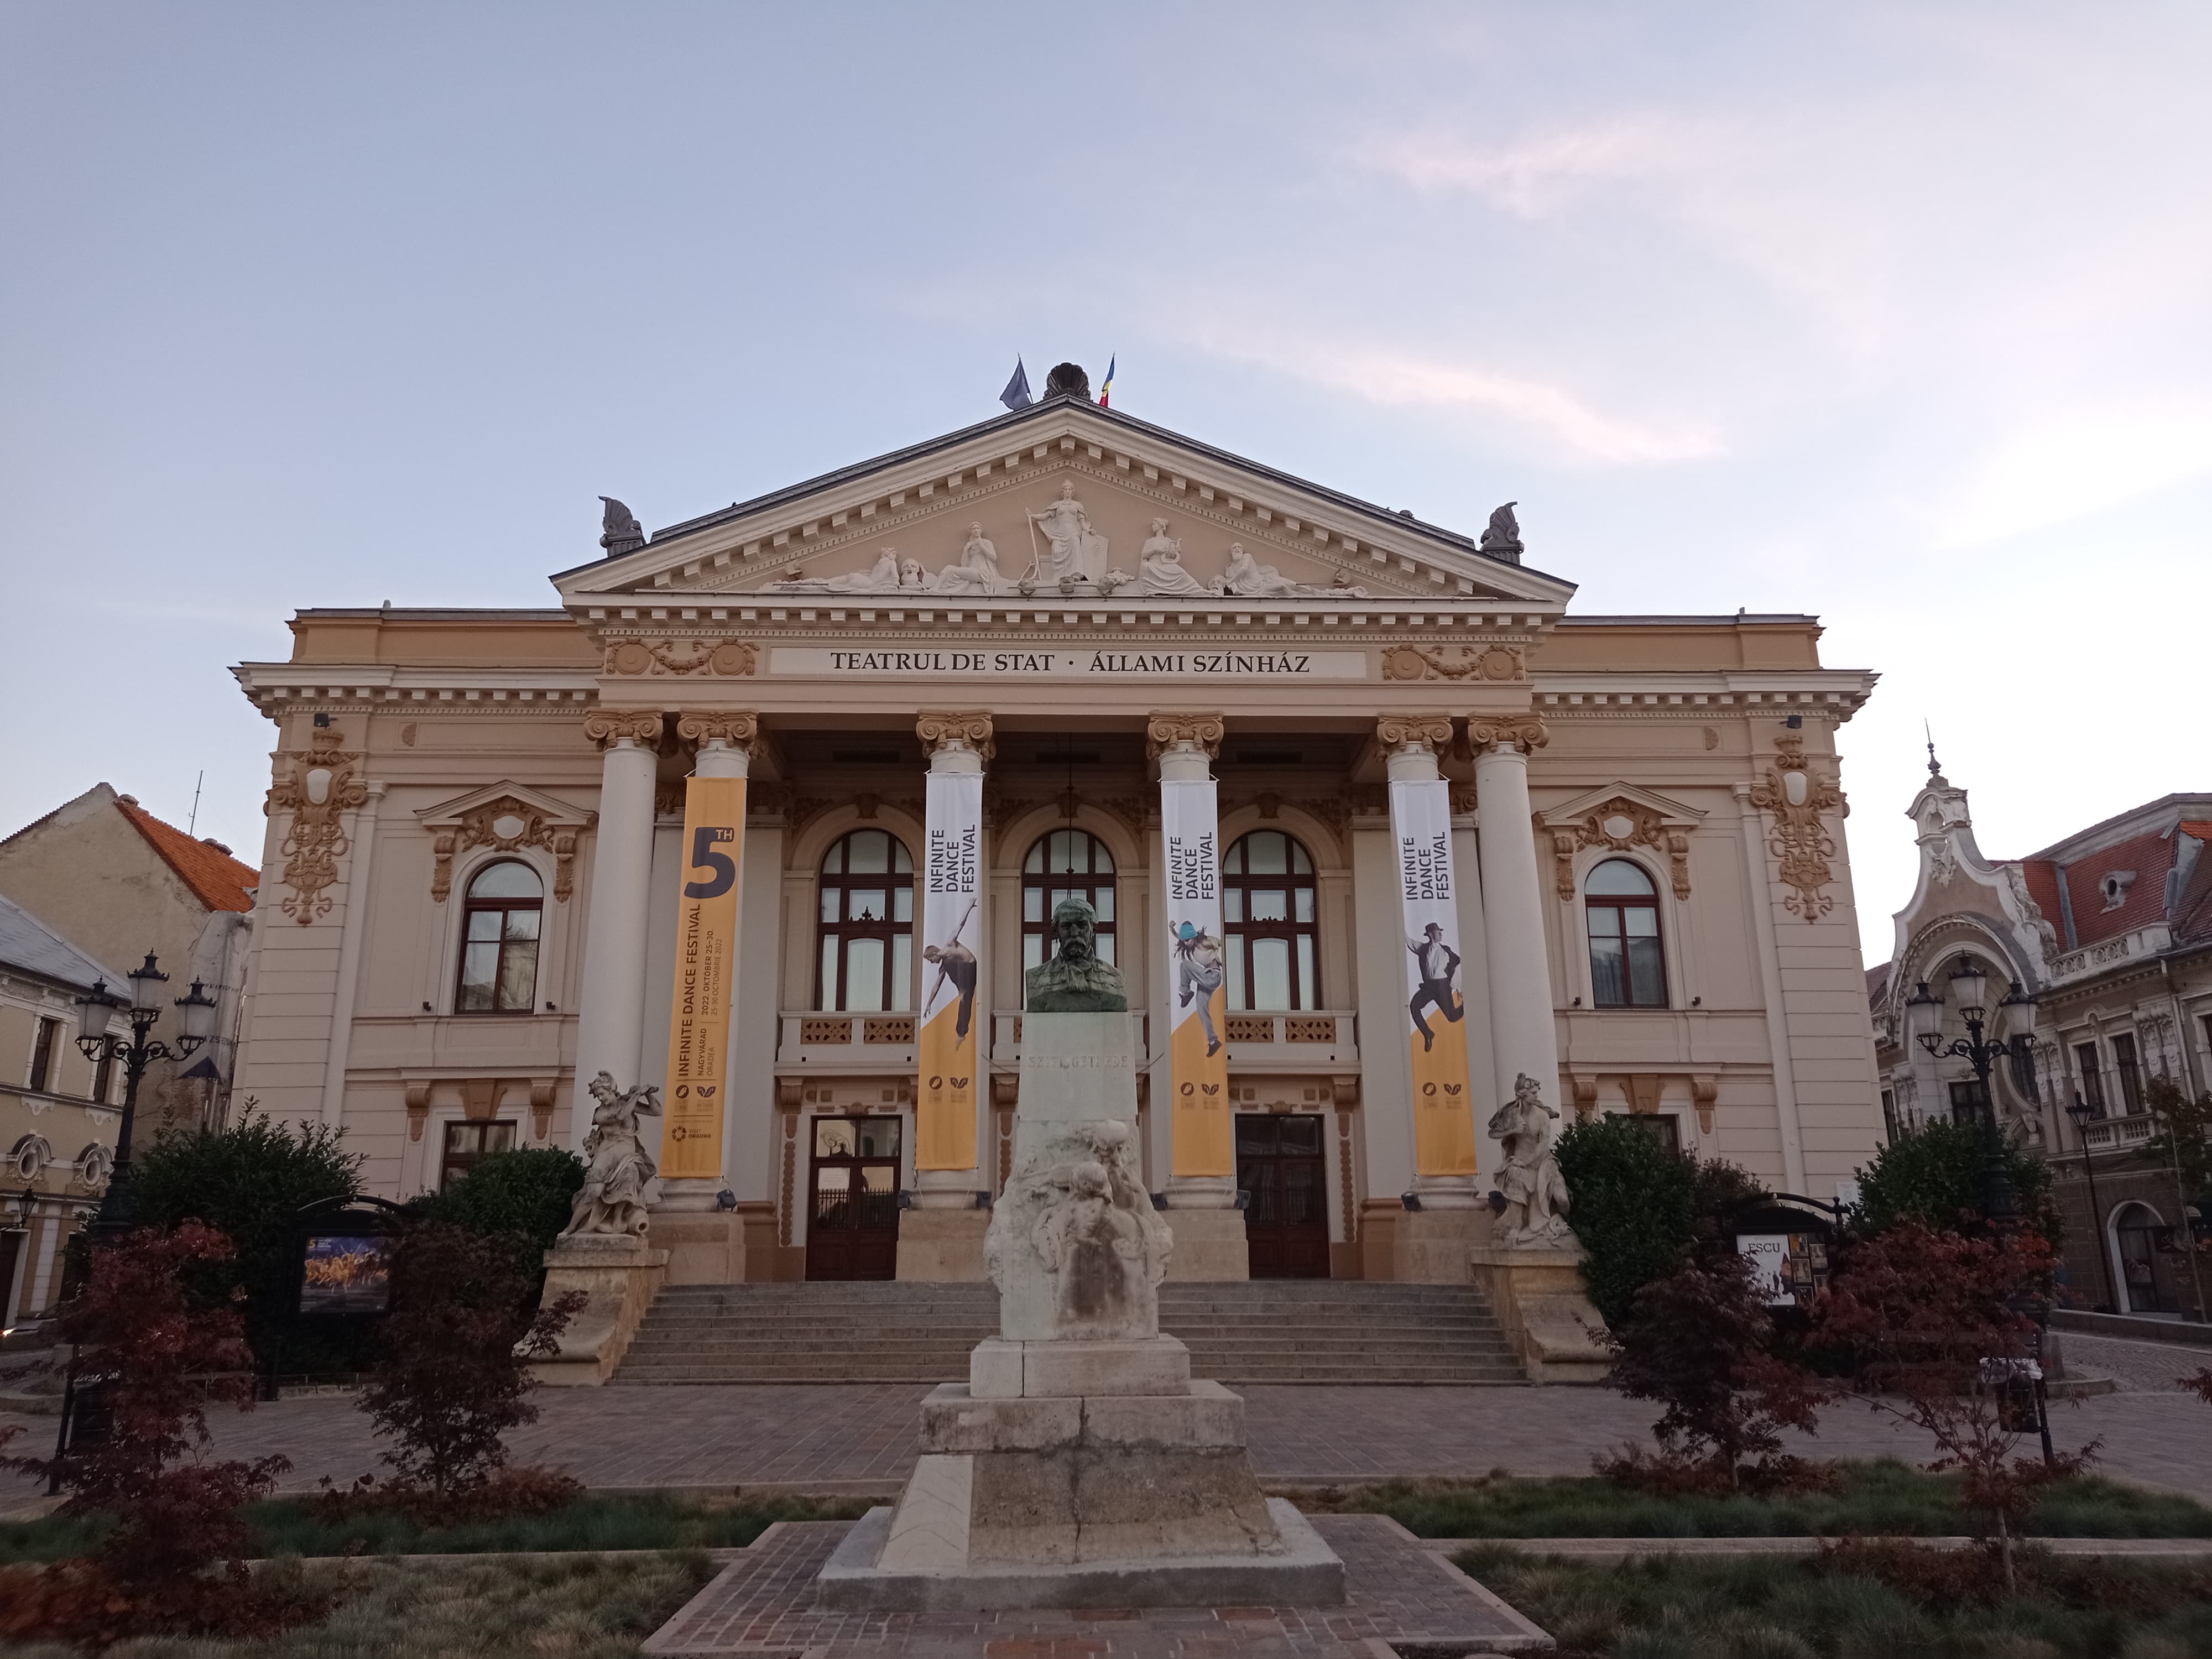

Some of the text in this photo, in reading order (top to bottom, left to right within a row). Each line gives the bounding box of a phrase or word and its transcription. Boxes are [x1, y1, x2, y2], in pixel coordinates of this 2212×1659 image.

[830, 651, 1310, 673] TEATRUL DE STAT ÁLLAMI SZÍNHÁZ
[931, 830, 944, 893] INFINITE
[946, 842, 959, 893] DANCE
[962, 825, 975, 893] FESTIVAL
[1170, 836, 1183, 900] INFINITE
[1185, 849, 1198, 899] DANCE
[1199, 832, 1214, 900] FESTIVAL
[1403, 837, 1418, 900] INFINITE
[1418, 849, 1434, 900] DANCE
[1433, 832, 1449, 900] FESTIVAL
[678, 904, 701, 1077] INFINITE DANCE FESTIVAL
[712, 956, 721, 995] OCTOMBRIE
[701, 994, 709, 1015] 2022.
[697, 1028, 707, 1076] NAGYVÁRAD
[1748, 1243, 1781, 1253] ESCU
